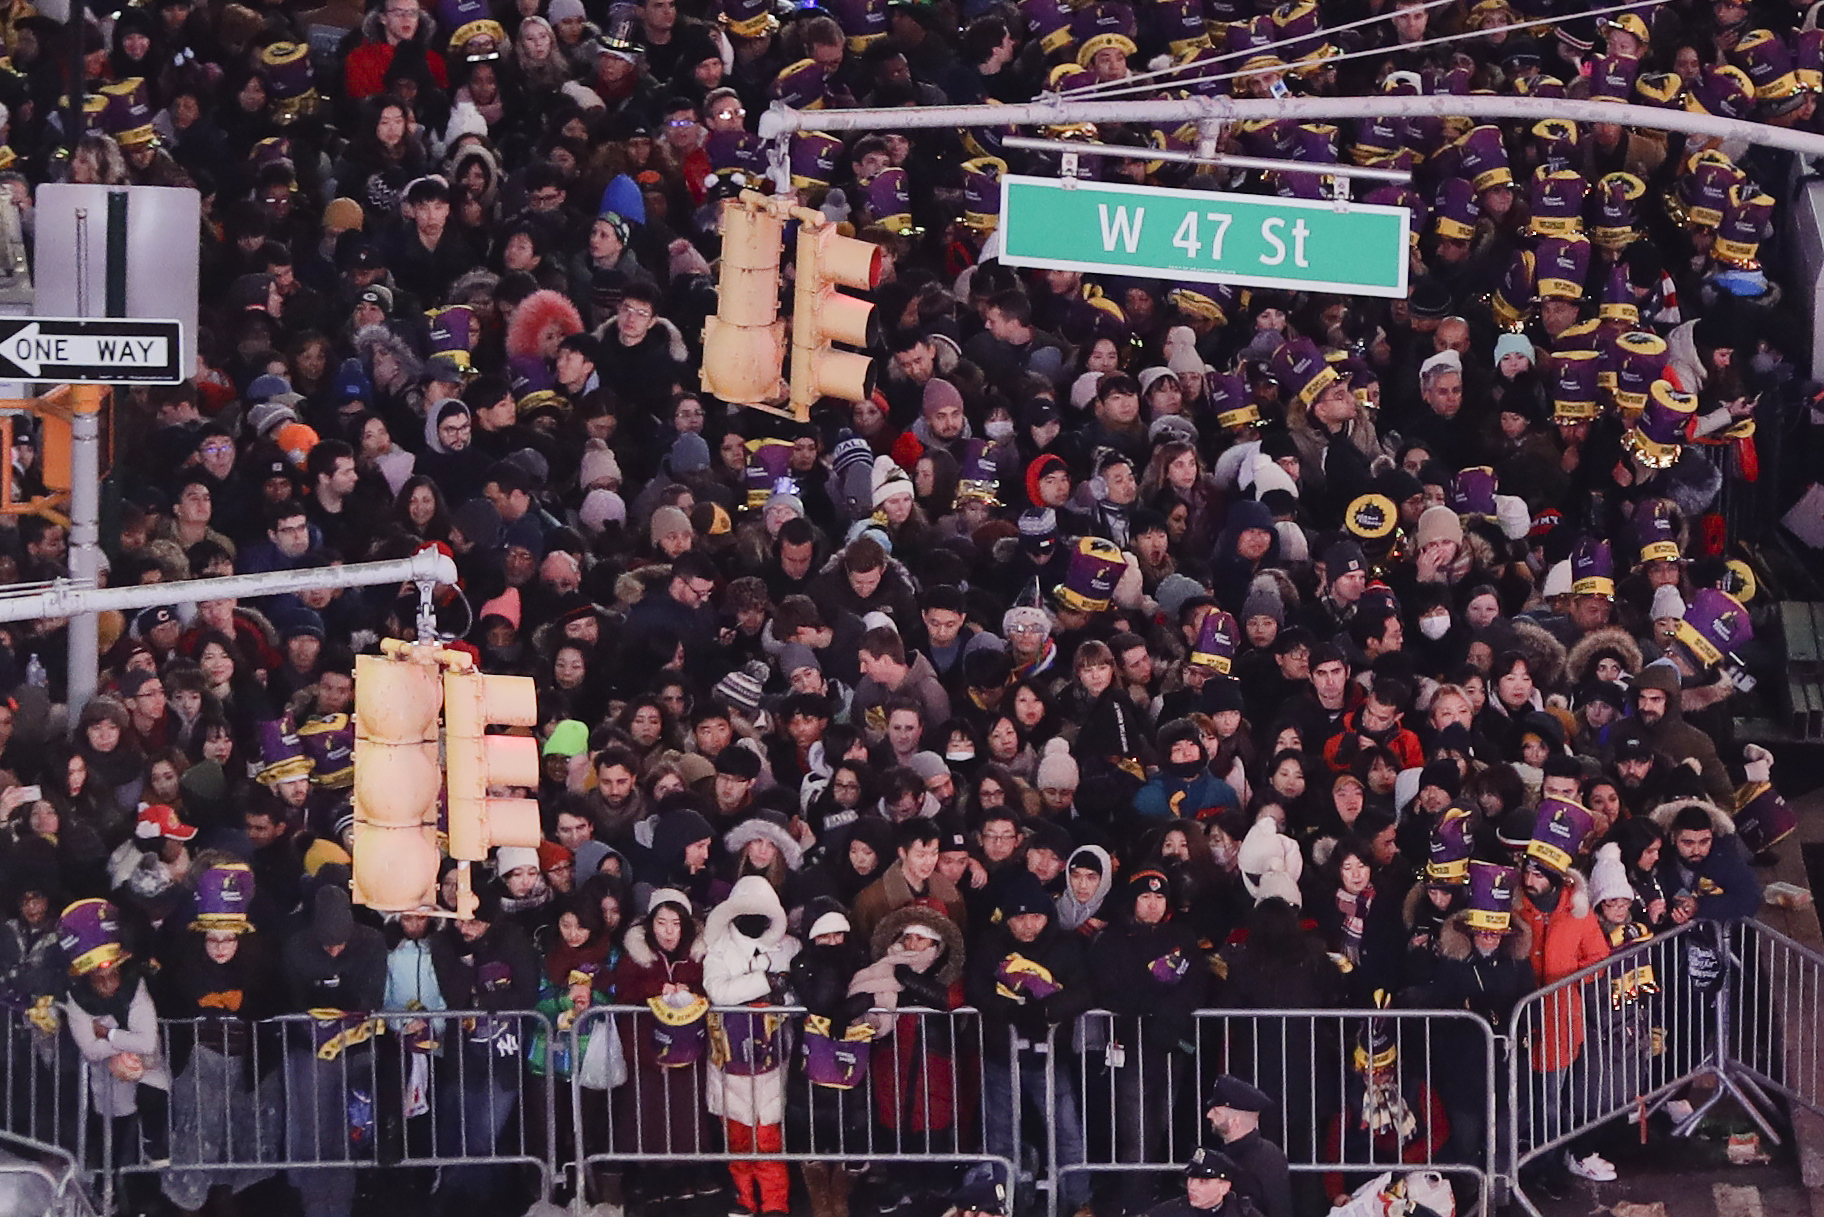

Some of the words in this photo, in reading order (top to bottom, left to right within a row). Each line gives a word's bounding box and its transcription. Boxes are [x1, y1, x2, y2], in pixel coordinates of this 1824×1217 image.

[1098, 203, 1145, 253] W
[1172, 211, 1233, 260] 47
[1258, 217, 1312, 268] St
[15, 338, 69, 361] ONE
[97, 339, 155, 363] WAY
